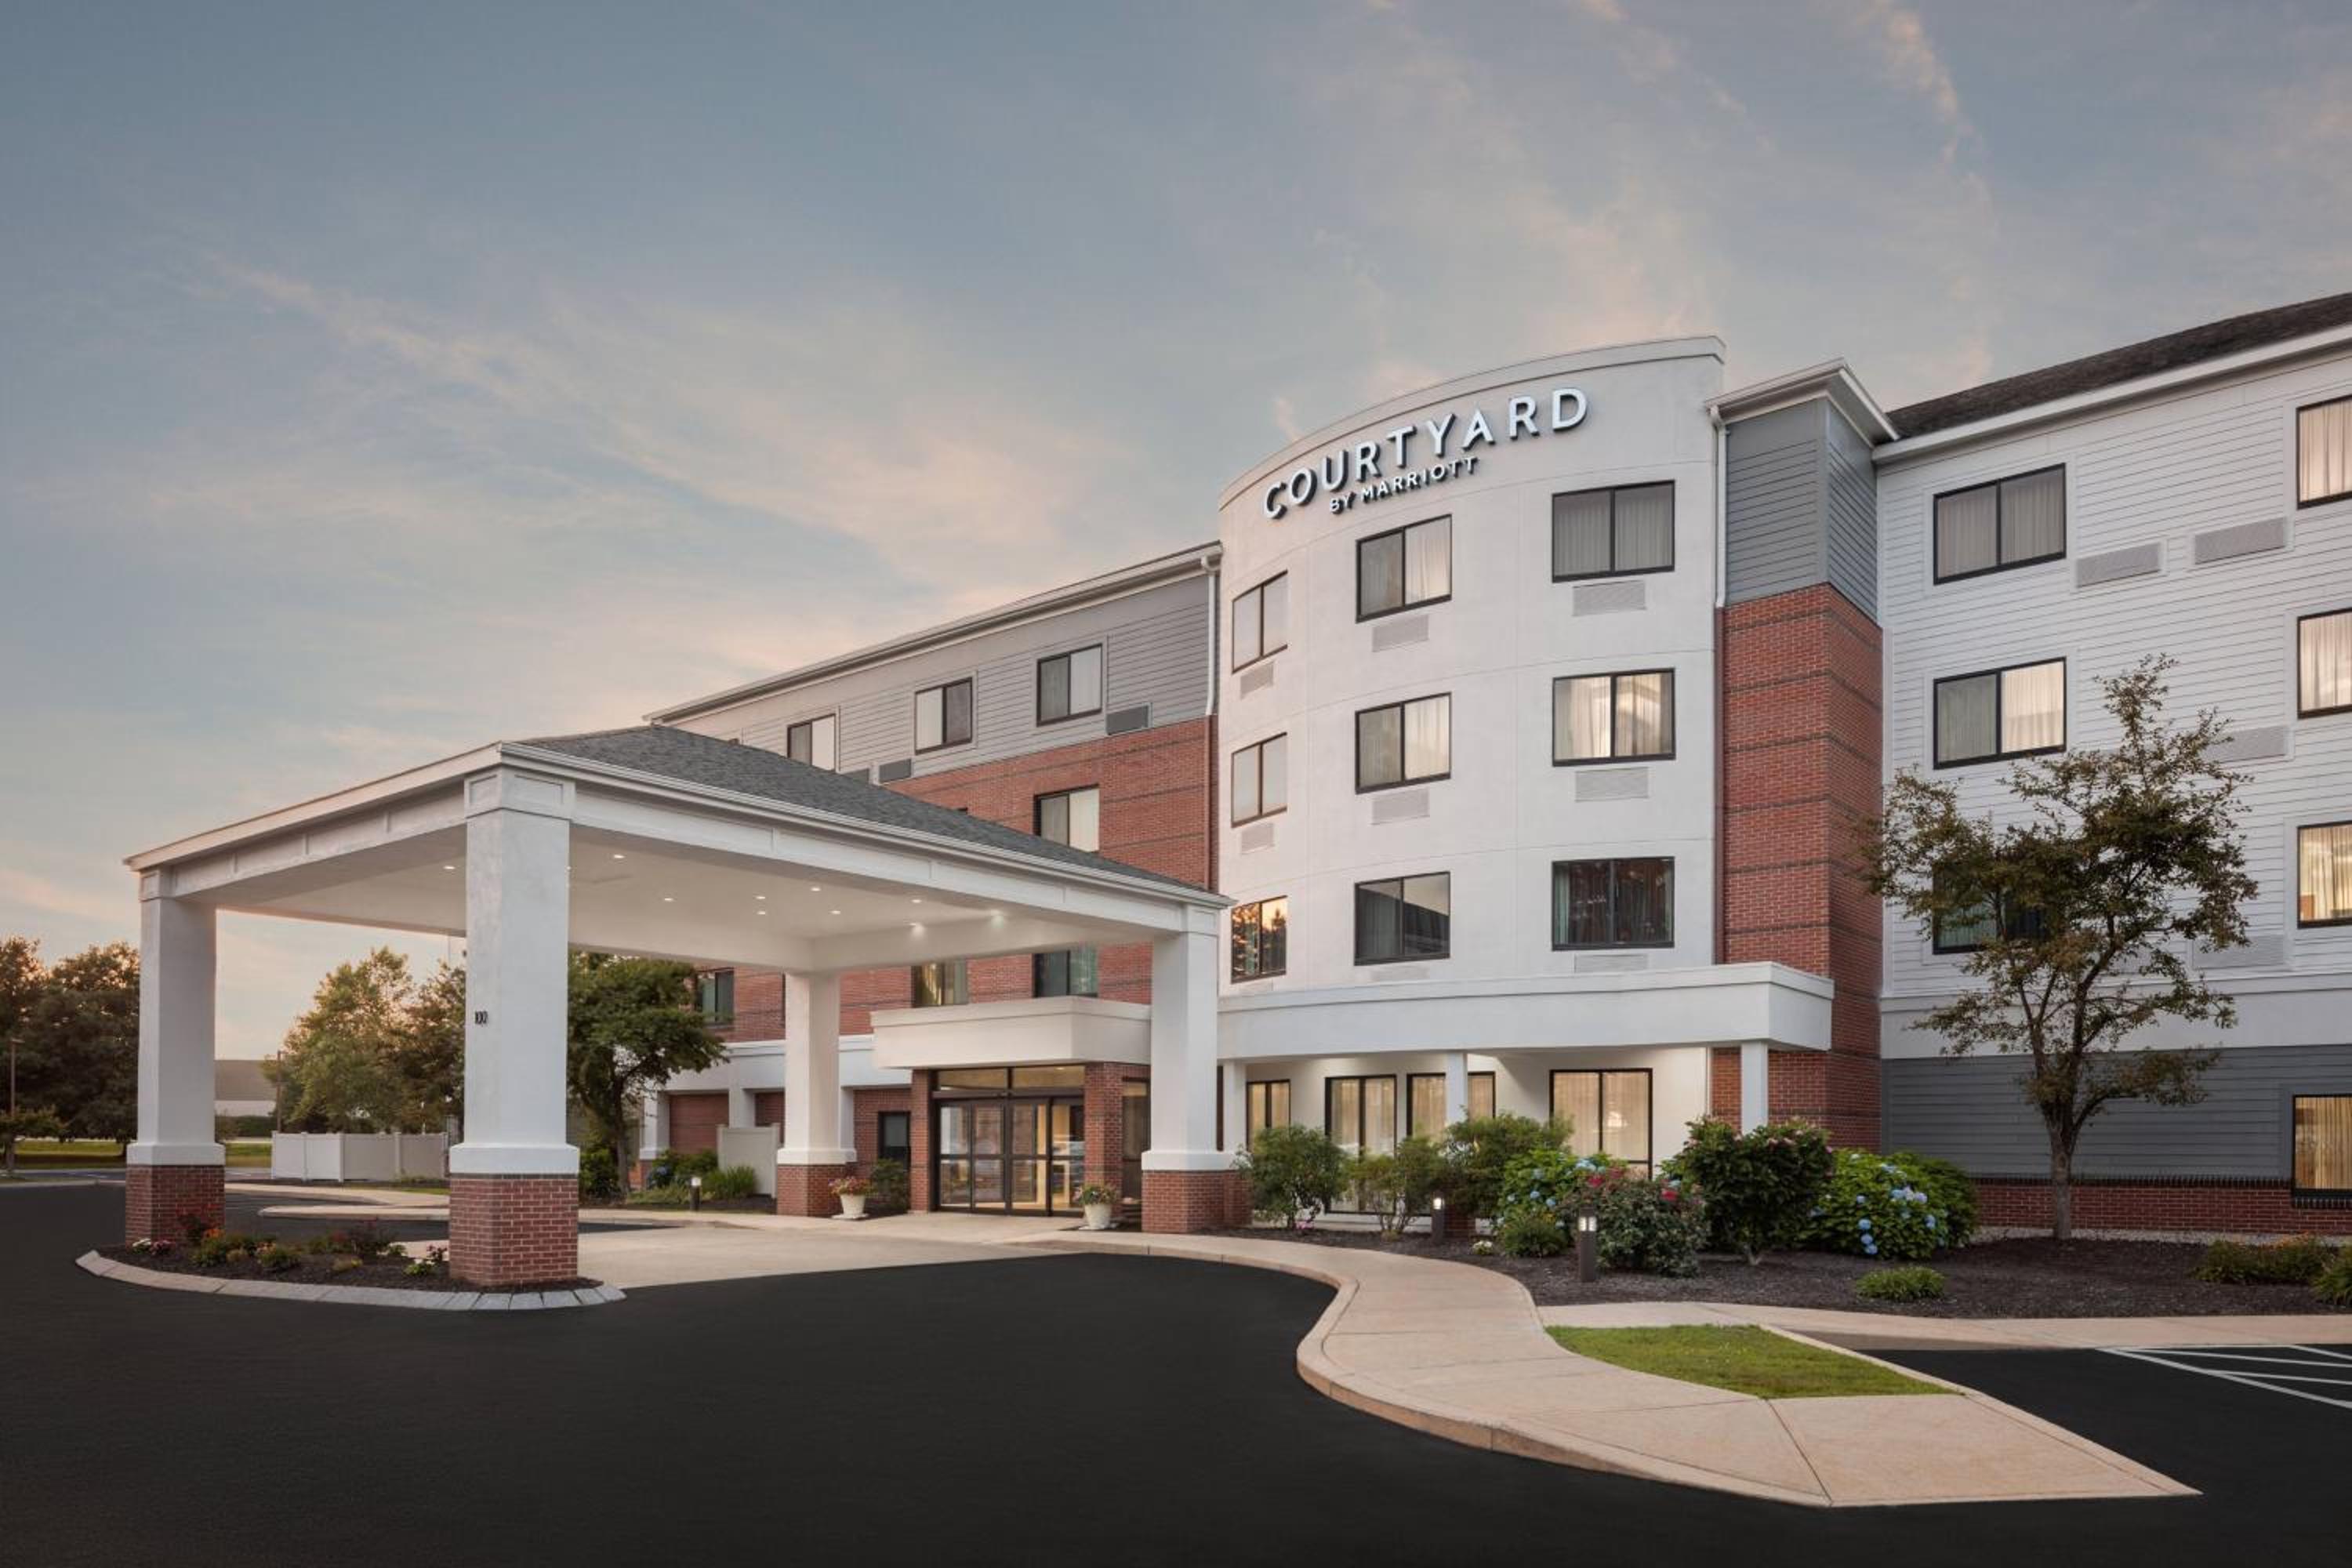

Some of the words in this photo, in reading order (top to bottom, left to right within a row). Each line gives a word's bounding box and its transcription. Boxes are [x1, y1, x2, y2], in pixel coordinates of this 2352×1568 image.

[1263, 388, 1589, 520] COURTYARD
[1329, 492, 1356, 514] BY
[1361, 456, 1479, 503] MARRIOTT
